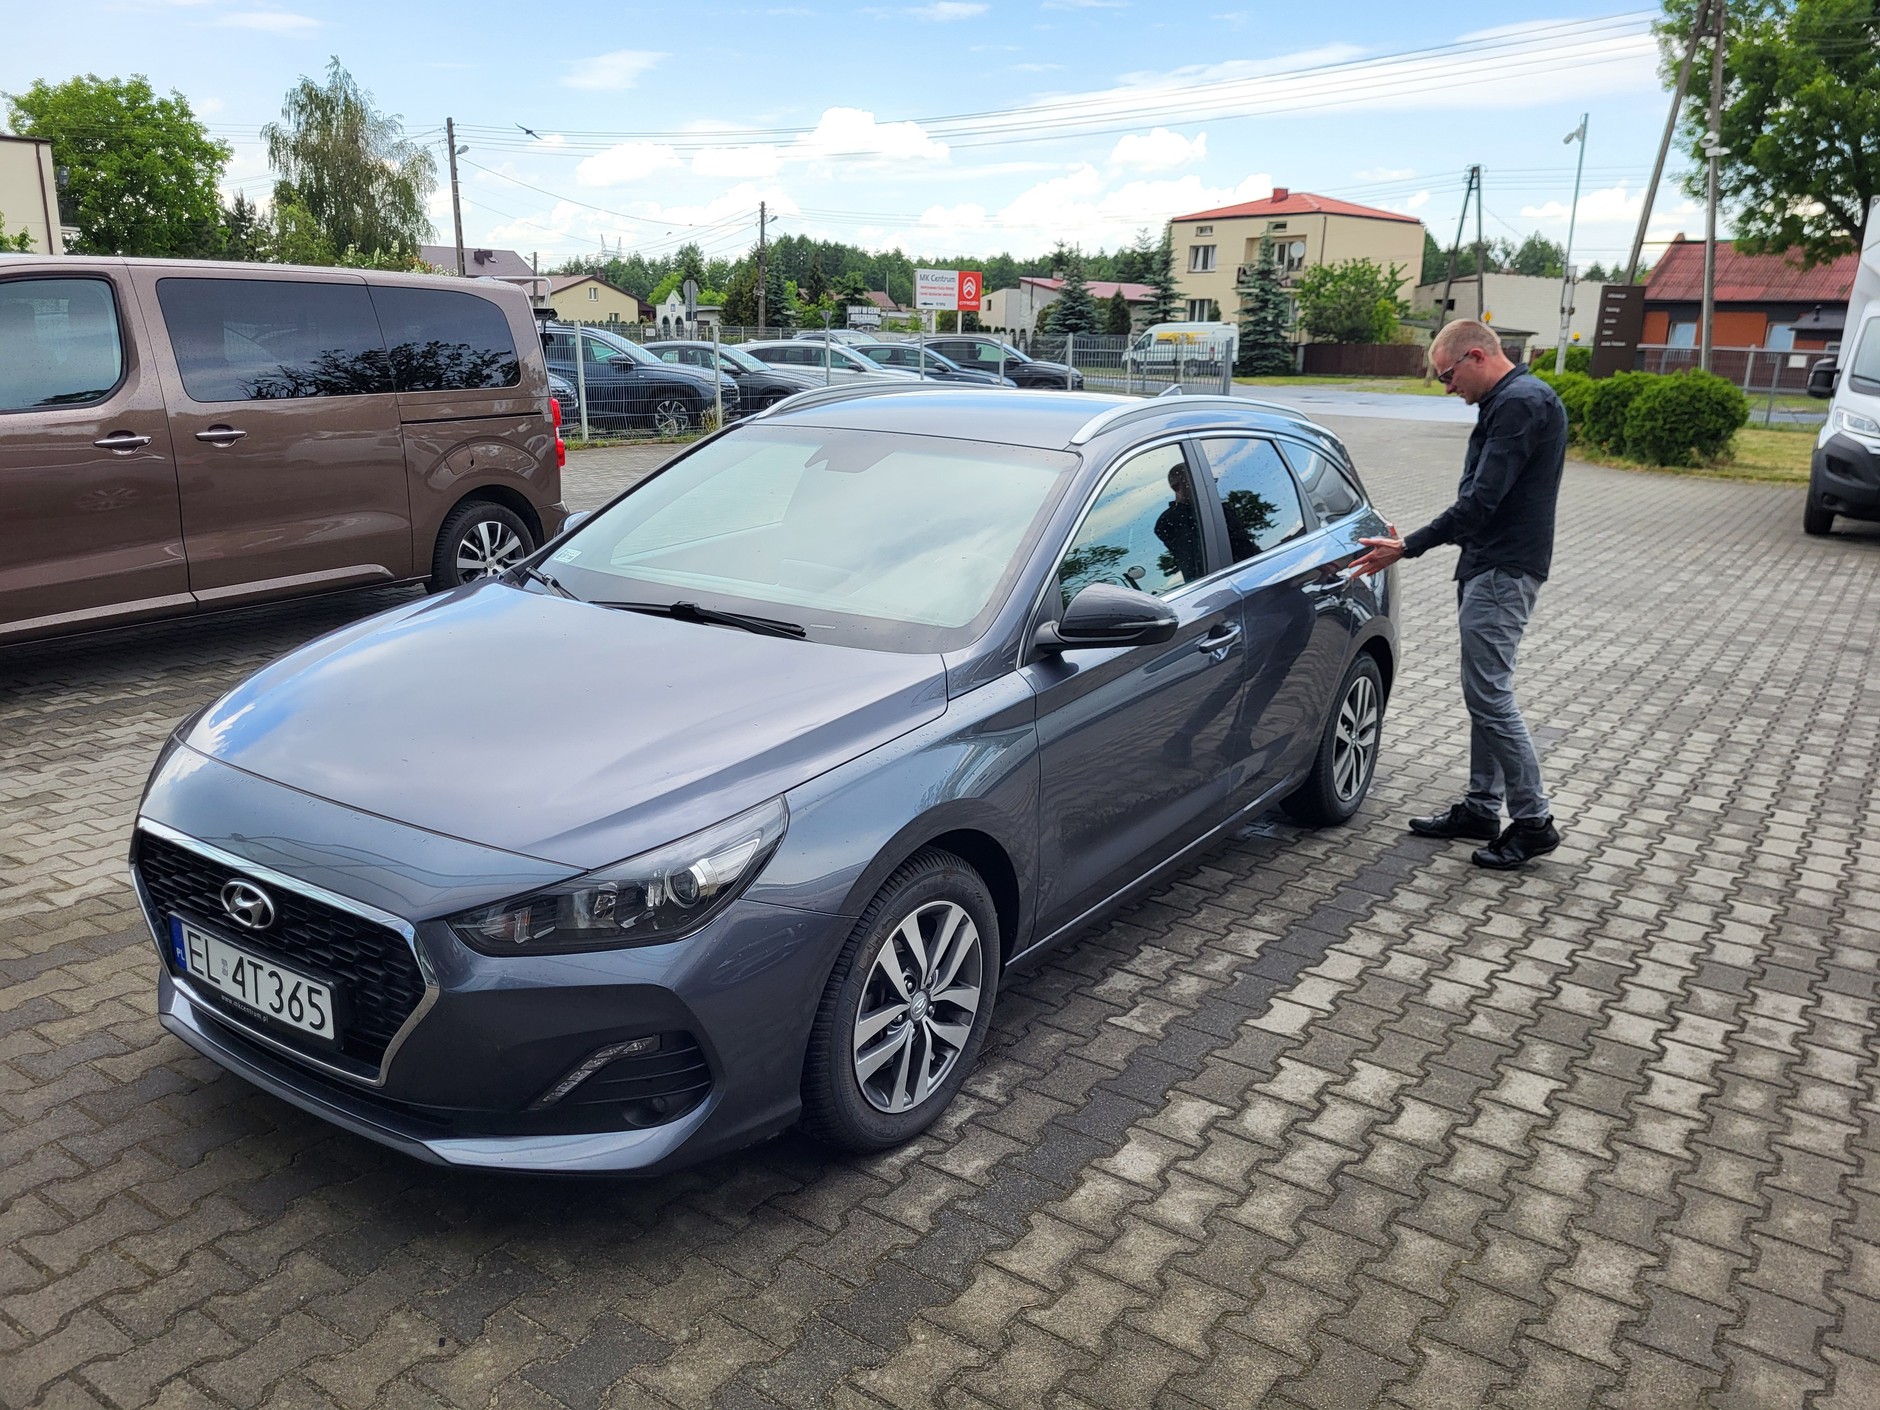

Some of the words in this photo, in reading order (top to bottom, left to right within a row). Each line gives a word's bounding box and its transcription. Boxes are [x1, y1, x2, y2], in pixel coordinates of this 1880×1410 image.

[919, 274, 930, 282] MK
[930, 274, 956, 283] Centrum
[176, 947, 185, 961] PL
[187, 929, 221, 985] EL
[232, 955, 326, 1031] 4T365
[221, 994, 269, 1023] www.mkcentrum.pl
